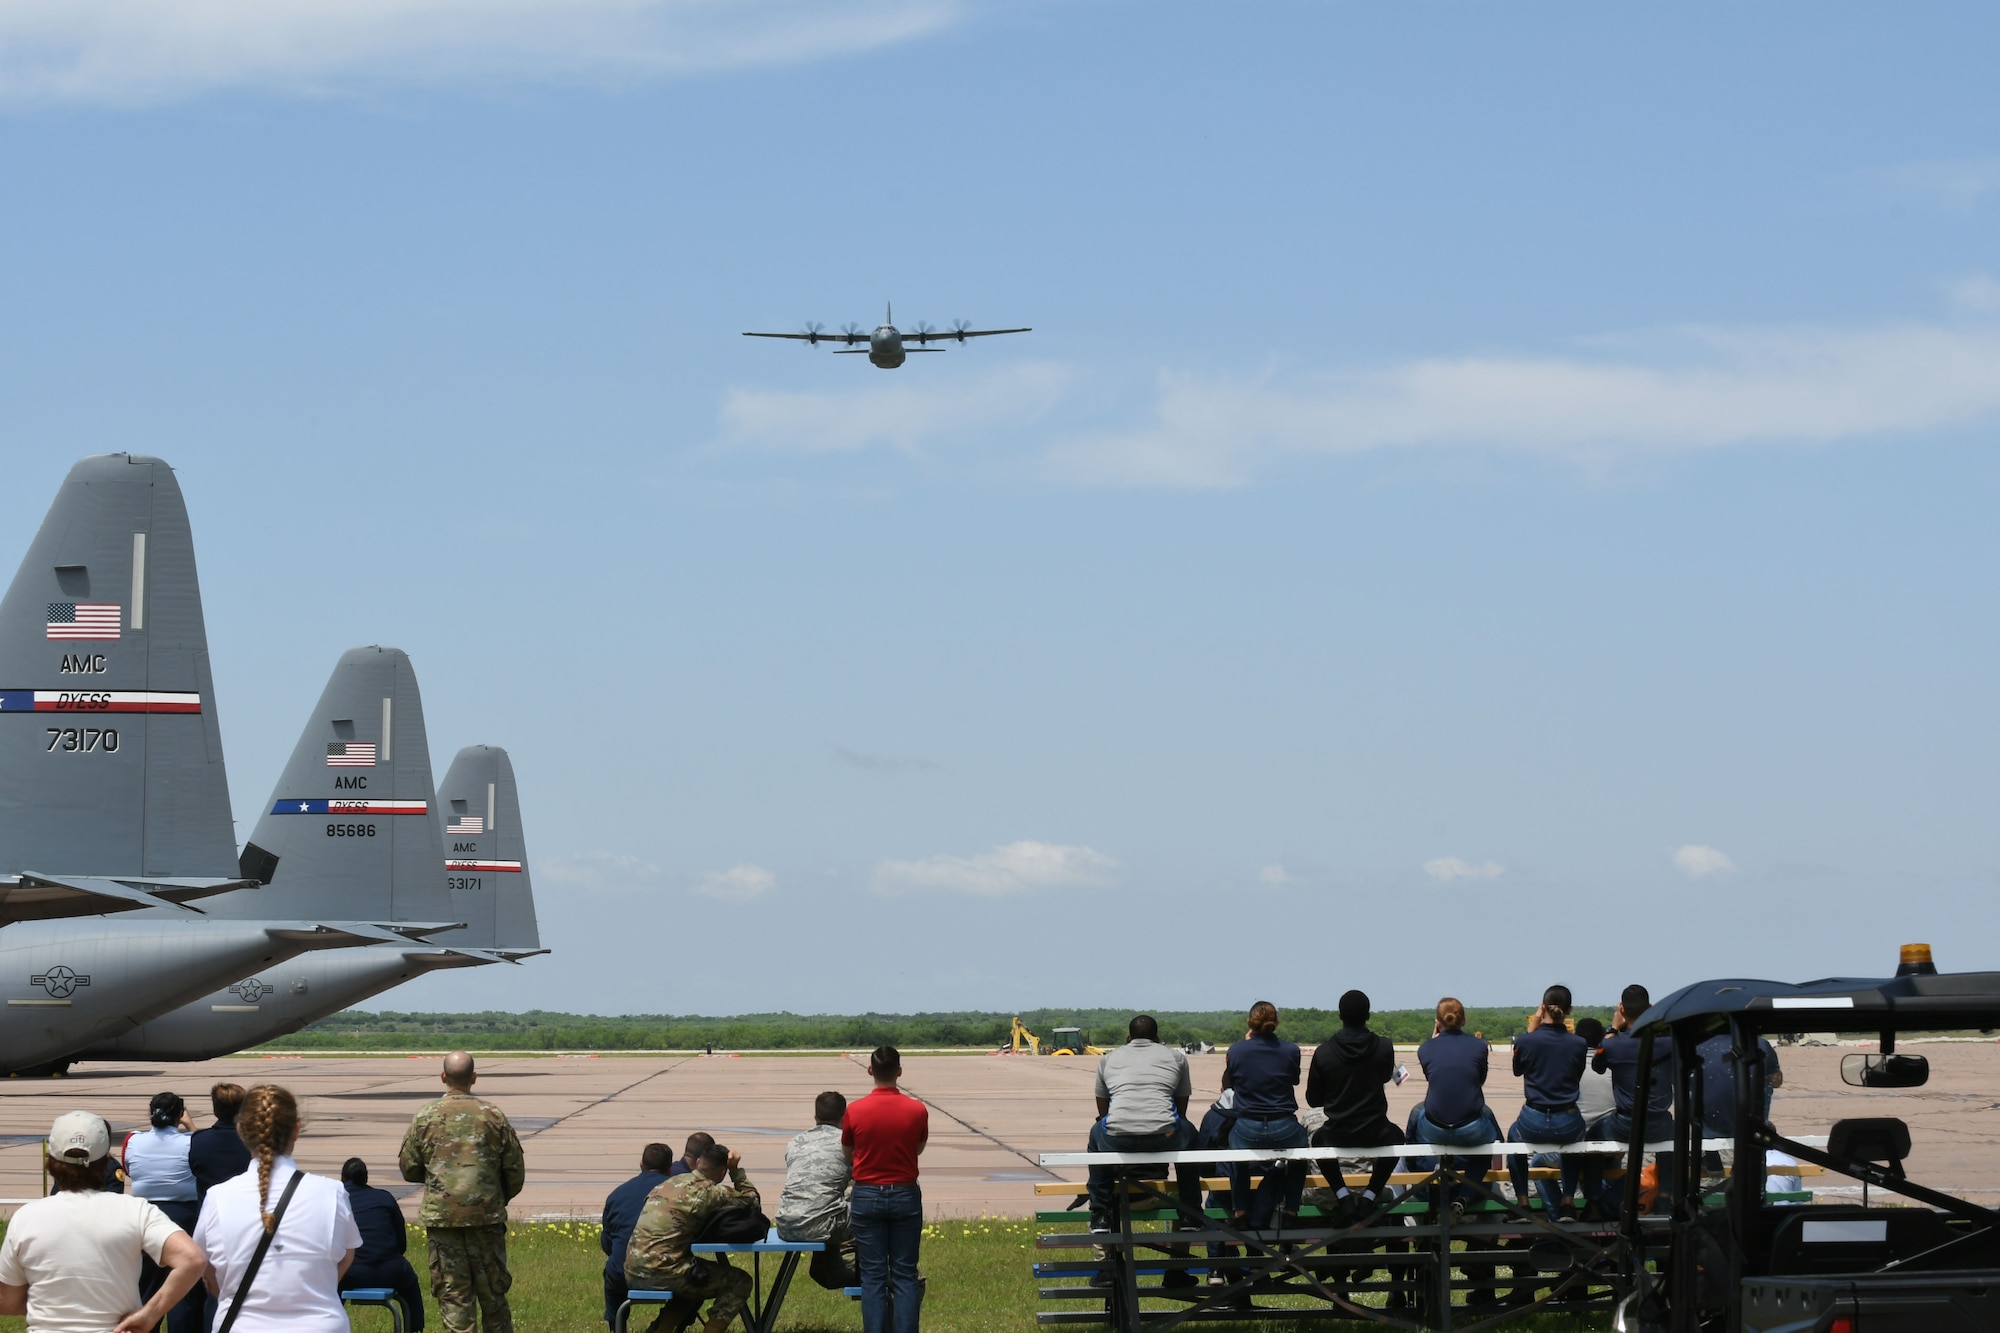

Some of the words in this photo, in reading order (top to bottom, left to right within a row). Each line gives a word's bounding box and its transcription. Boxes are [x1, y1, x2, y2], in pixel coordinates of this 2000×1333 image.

[60, 654, 107, 674] AMC
[56, 693, 111, 709] DYESS
[47, 728, 119, 753] 73170
[334, 776, 367, 789] AMC
[333, 801, 369, 812] DYESS
[326, 824, 376, 837] 85686
[453, 842, 477, 853] AMC
[69, 1135, 85, 1144] citi
